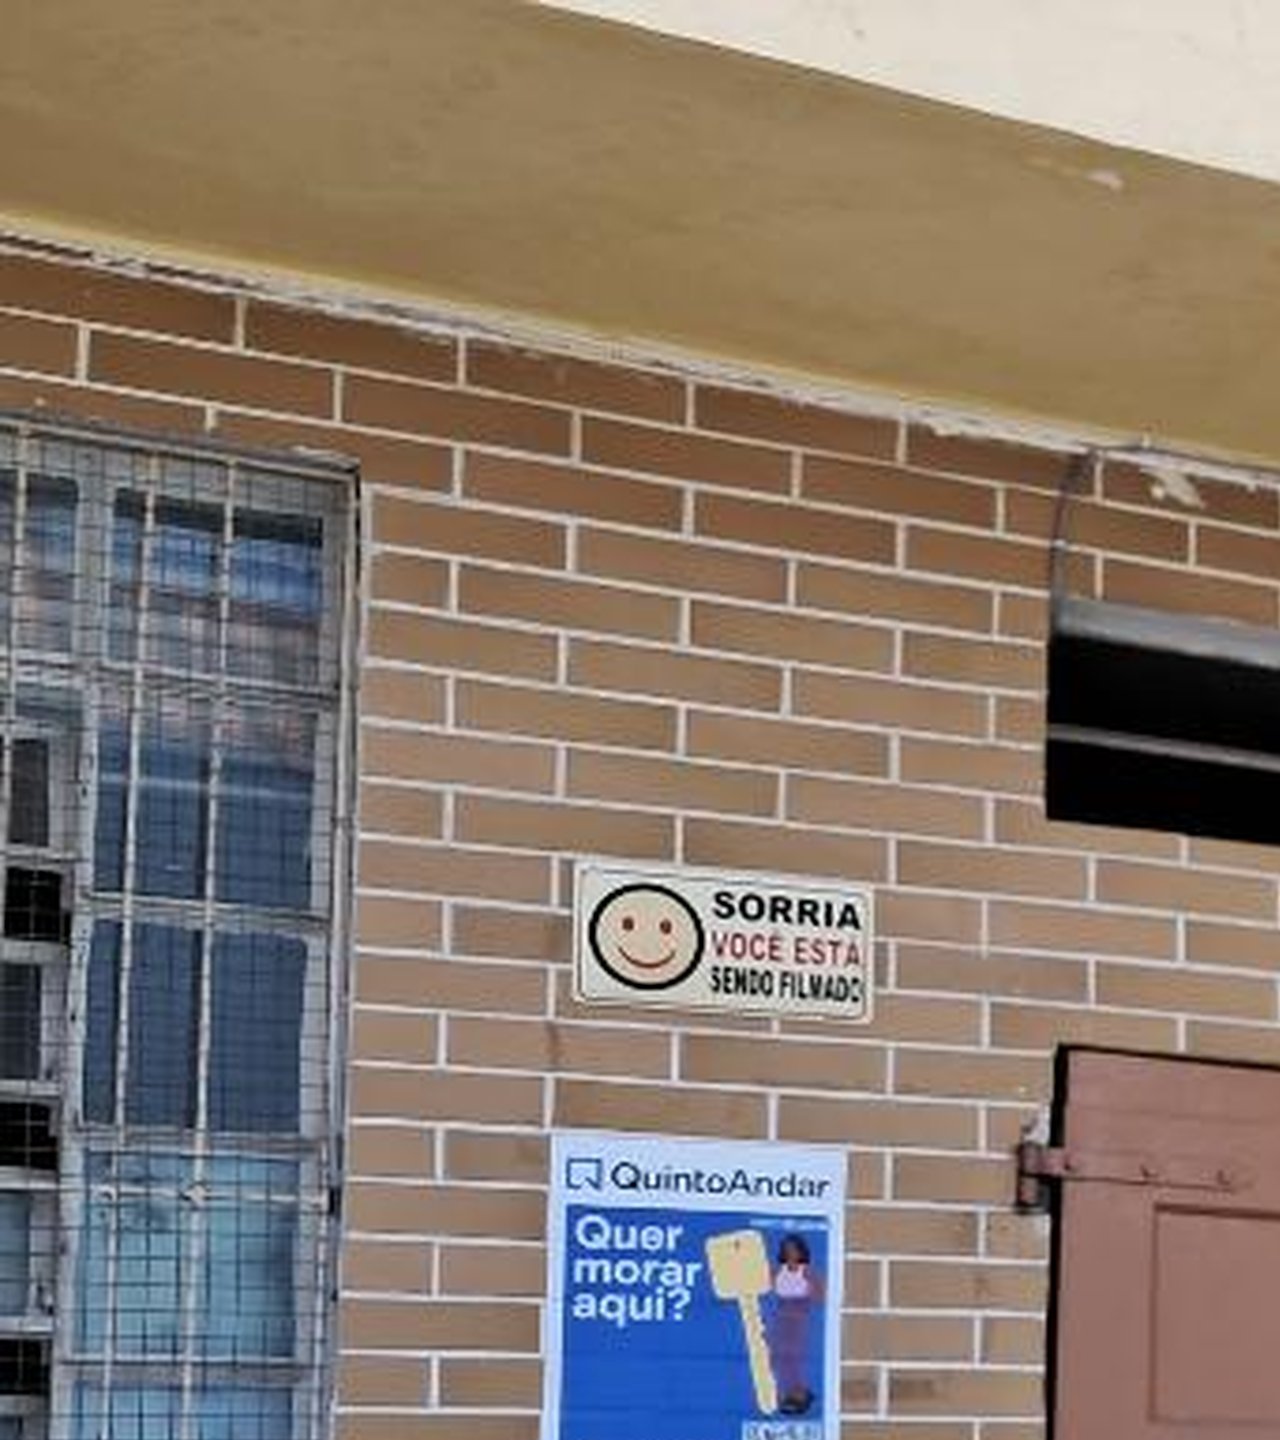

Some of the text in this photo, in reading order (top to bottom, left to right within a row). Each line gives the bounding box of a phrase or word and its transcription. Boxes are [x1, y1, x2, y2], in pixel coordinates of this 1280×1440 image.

[713, 891, 860, 930] SORRIA
[711, 966, 864, 1003] SENDO FILMADO
[611, 1160, 830, 1199] QuintoAndar
[575, 1214, 684, 1251] Quer
[573, 1257, 702, 1288] morar
[573, 1290, 691, 1327] aqui?
